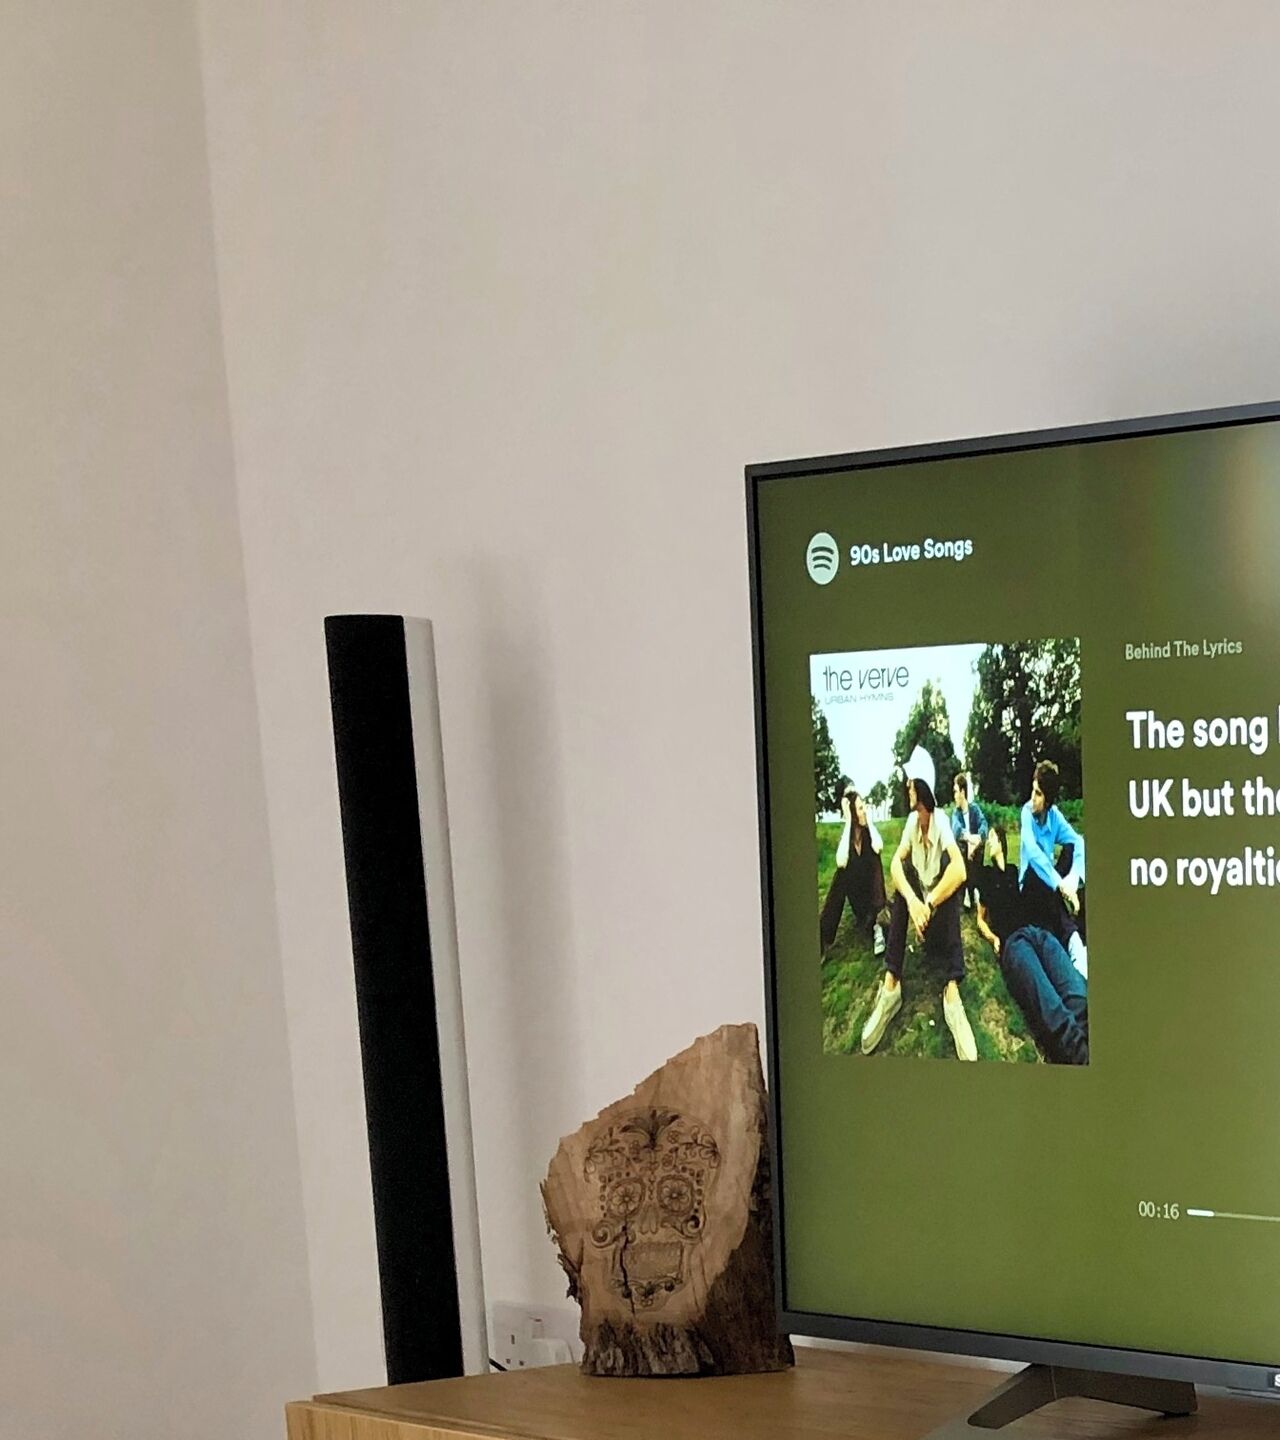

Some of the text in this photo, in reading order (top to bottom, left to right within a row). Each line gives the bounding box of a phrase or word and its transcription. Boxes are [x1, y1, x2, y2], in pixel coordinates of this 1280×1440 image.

[850, 538, 973, 567] 90s Love Songs
[1125, 638, 1243, 660] Behind The Lyrics
[823, 665, 910, 692] the verve
[1125, 710, 1185, 749] The
[1193, 716, 1269, 755] song
[1129, 778, 1175, 818] UK
[1182, 777, 1235, 817] but
[1130, 857, 1168, 886] no
[1138, 1201, 1180, 1220] 00:16
